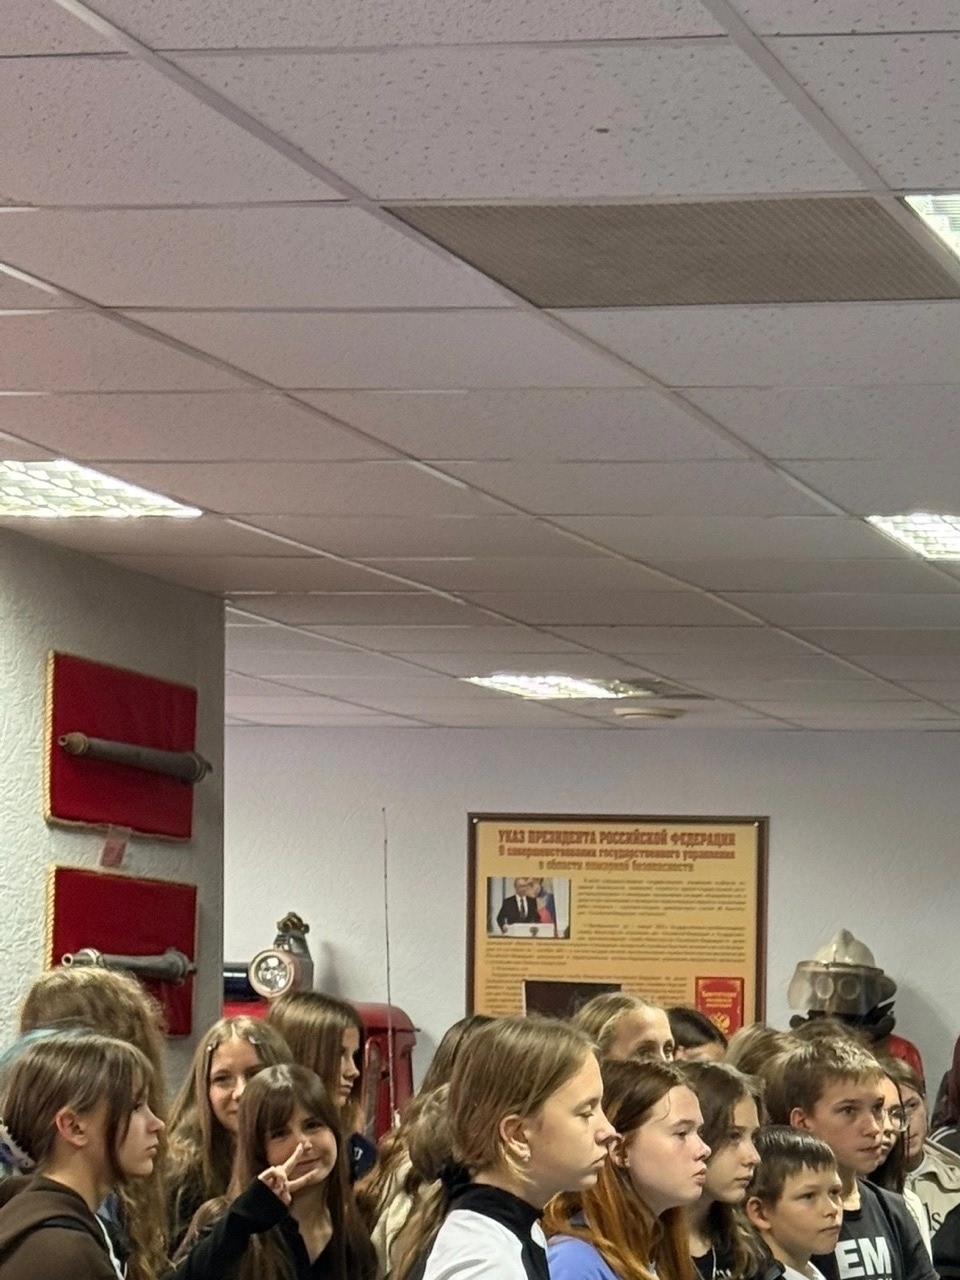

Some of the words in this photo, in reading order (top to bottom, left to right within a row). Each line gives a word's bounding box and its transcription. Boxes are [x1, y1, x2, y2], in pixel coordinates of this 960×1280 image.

[498, 829, 526, 844] УКАЗ
[528, 830, 597, 846] ПРЕЗИДЕНТА
[599, 829, 668, 845] РОССИЙСКОЙ
[670, 832, 736, 848] ФЕДЕРАЦИИ
[834, 1236, 892, 1280] EM
